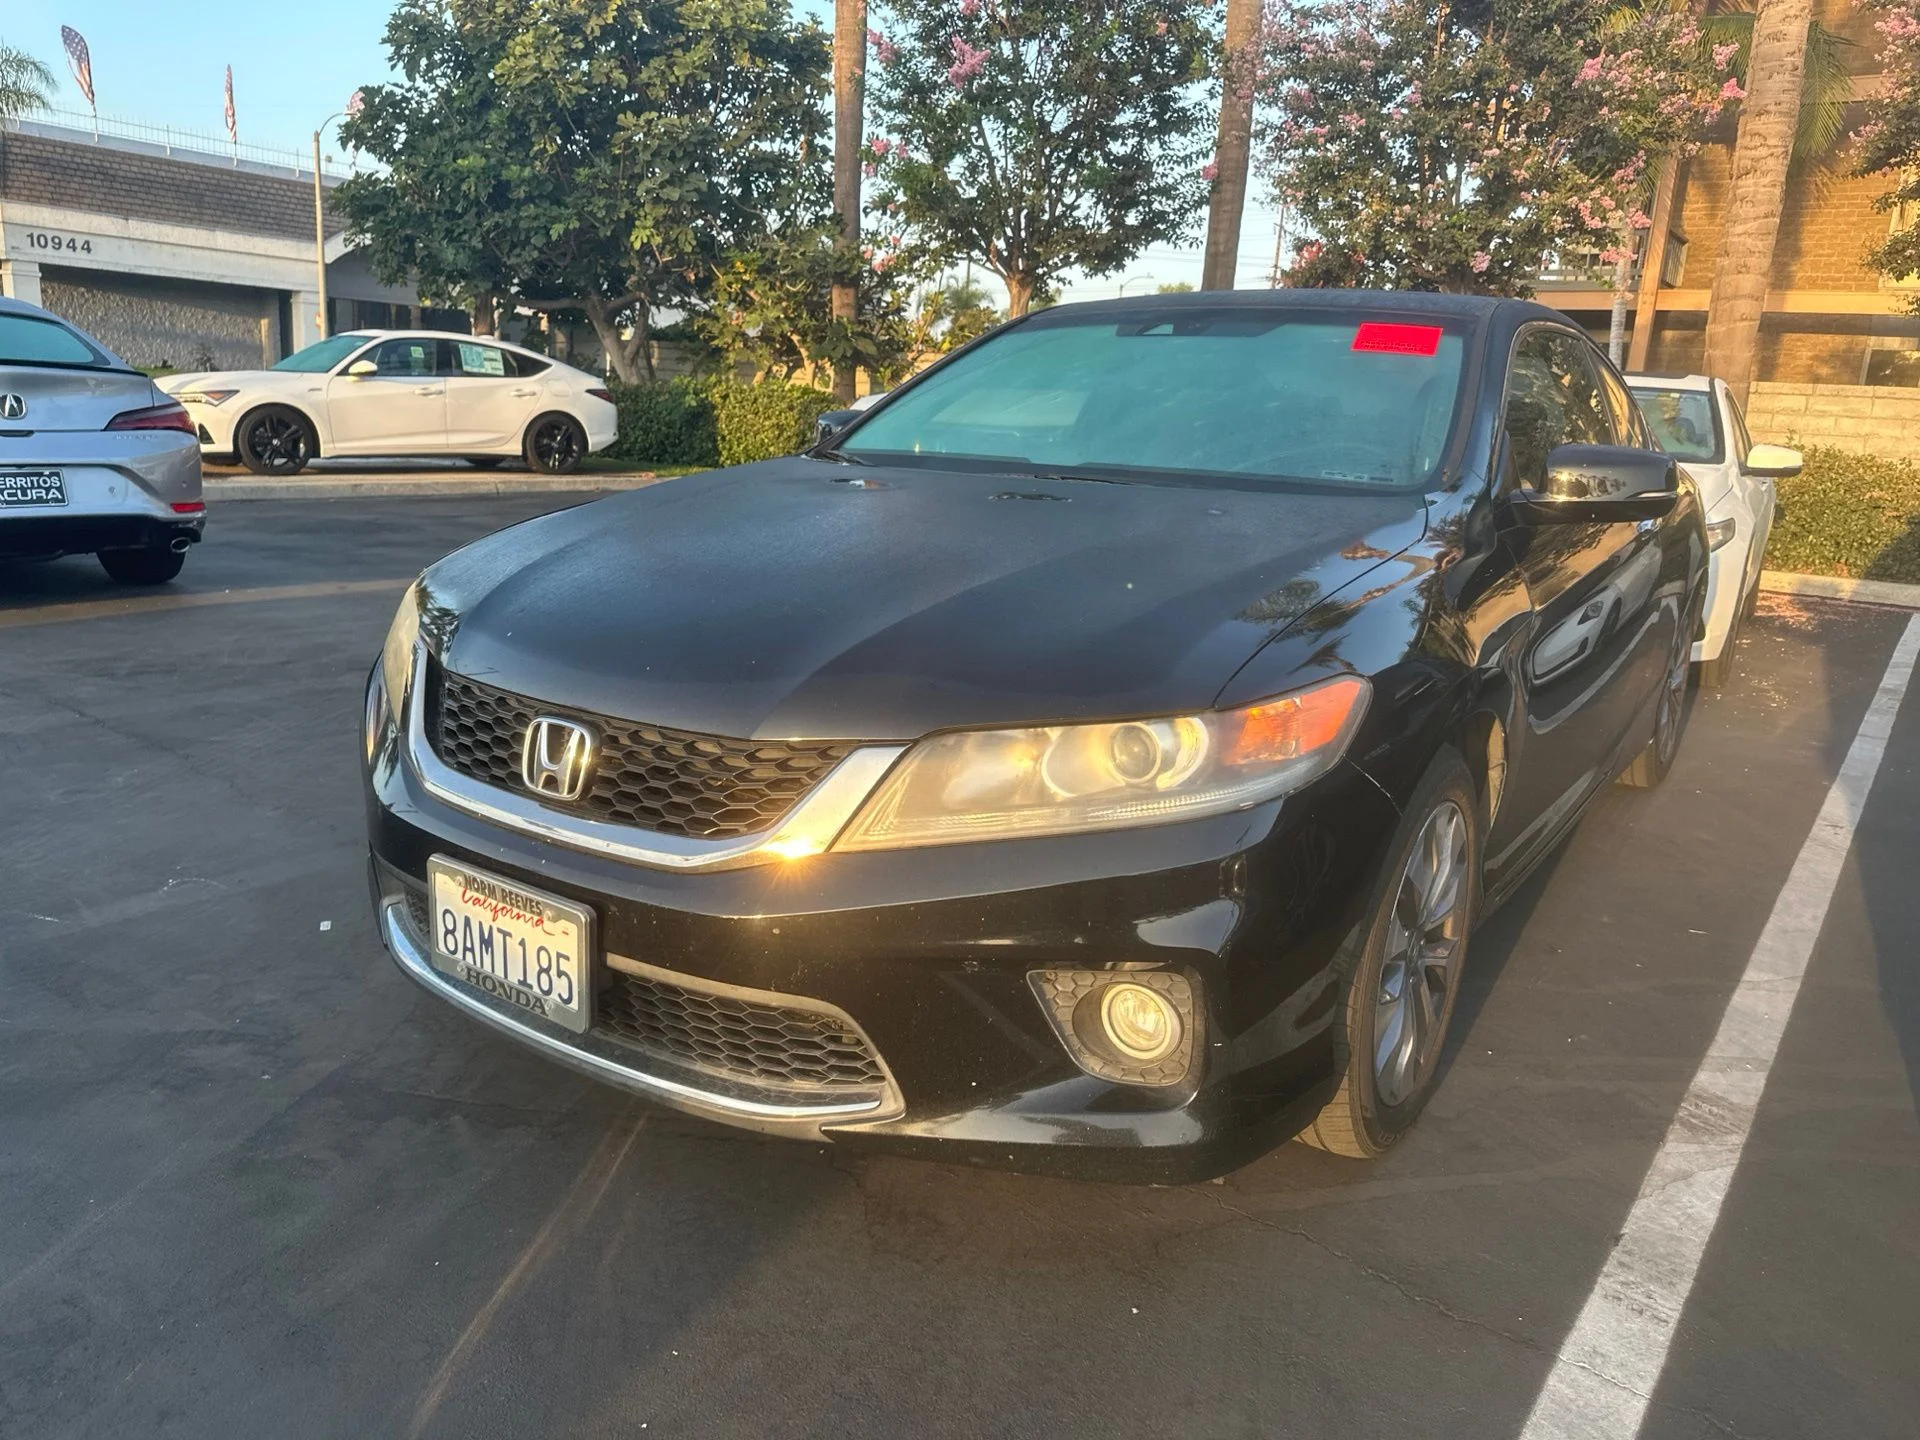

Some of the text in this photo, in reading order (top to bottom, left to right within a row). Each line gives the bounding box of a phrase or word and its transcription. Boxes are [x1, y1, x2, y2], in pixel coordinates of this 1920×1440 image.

[26, 232, 92, 254] 10944
[463, 873, 544, 916] NORM REEVES
[441, 907, 574, 1005] 8AMT185
[464, 966, 549, 1018] HONDA
